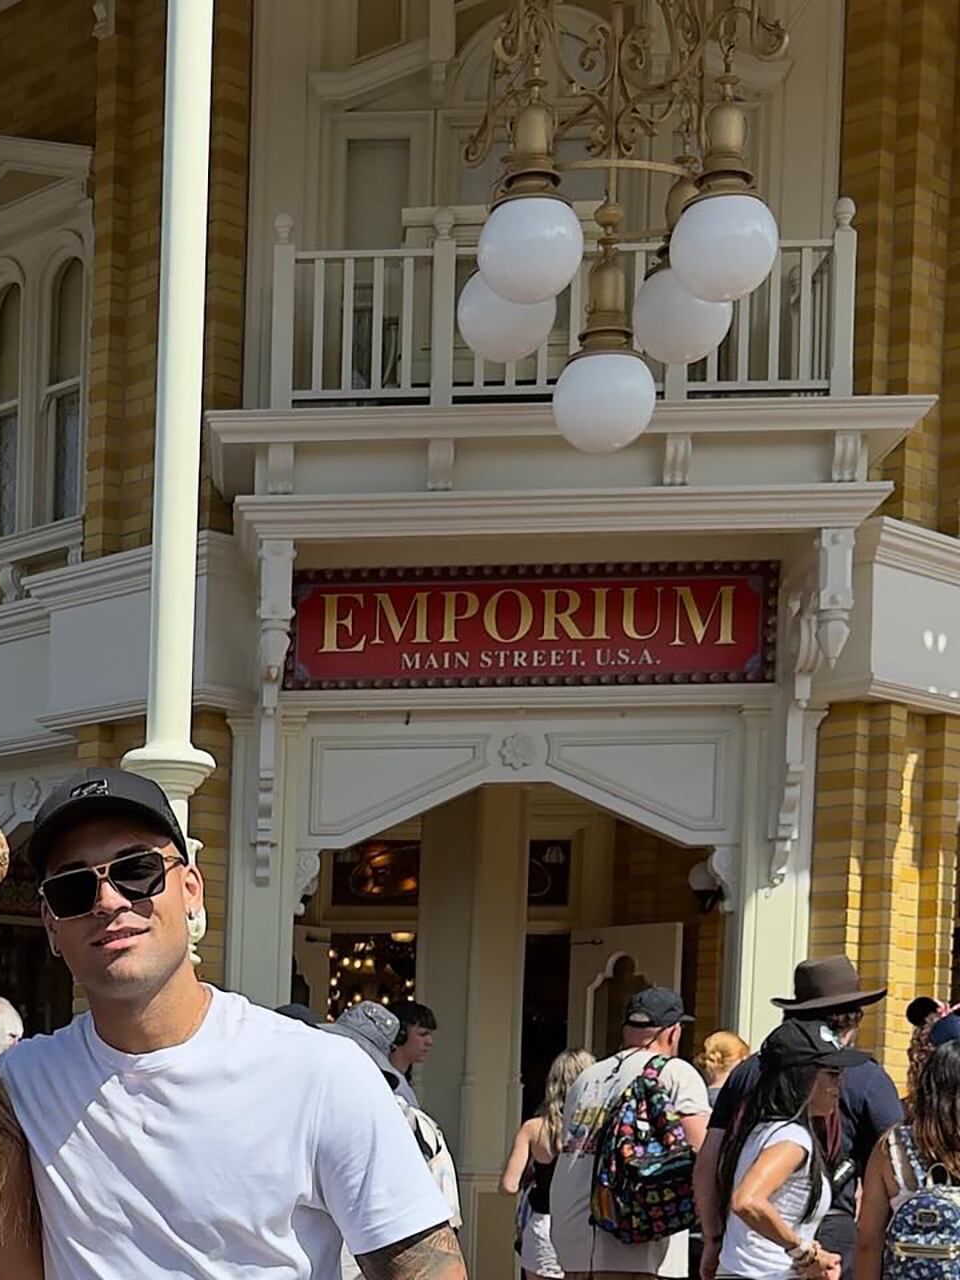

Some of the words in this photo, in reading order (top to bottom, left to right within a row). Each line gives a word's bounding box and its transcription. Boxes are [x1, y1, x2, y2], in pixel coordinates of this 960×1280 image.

[318, 586, 737, 653] EMPORIUM
[401, 651, 469, 669] MAIN
[596, 648, 661, 666] U.S.A.
